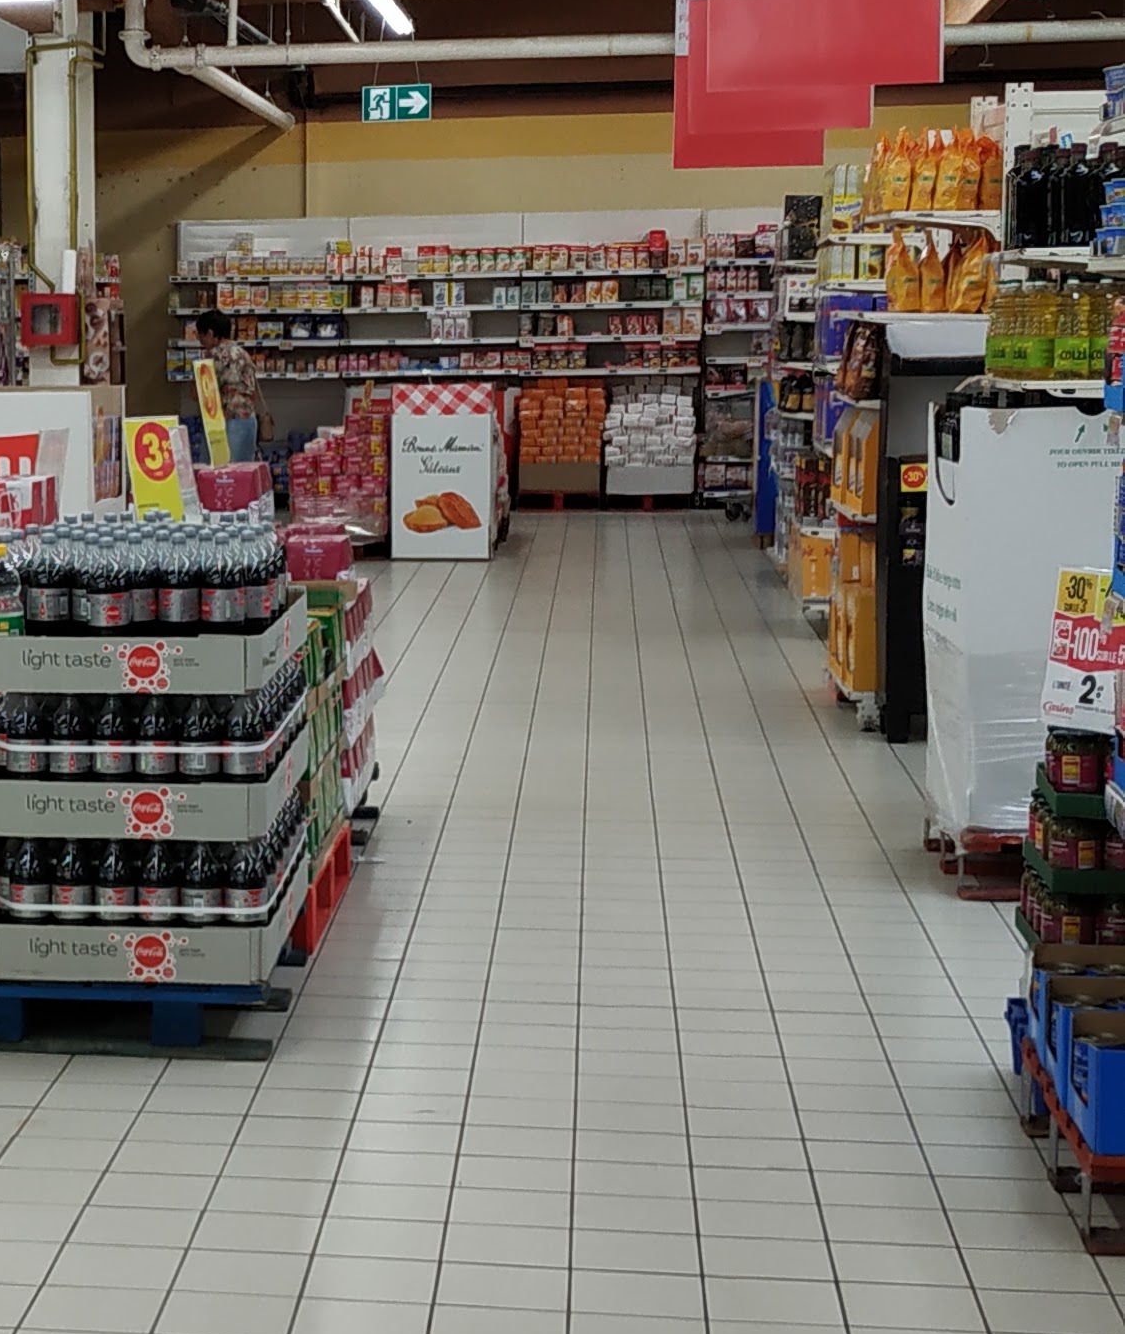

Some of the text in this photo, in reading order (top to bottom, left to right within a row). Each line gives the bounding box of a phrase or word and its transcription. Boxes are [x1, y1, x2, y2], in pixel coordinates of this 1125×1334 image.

[142, 432, 163, 470] 3
[22, 648, 111, 670] light taste
[1078, 675, 1097, 704] 2
[26, 793, 116, 815] light taste
[29, 937, 117, 958] light taste
